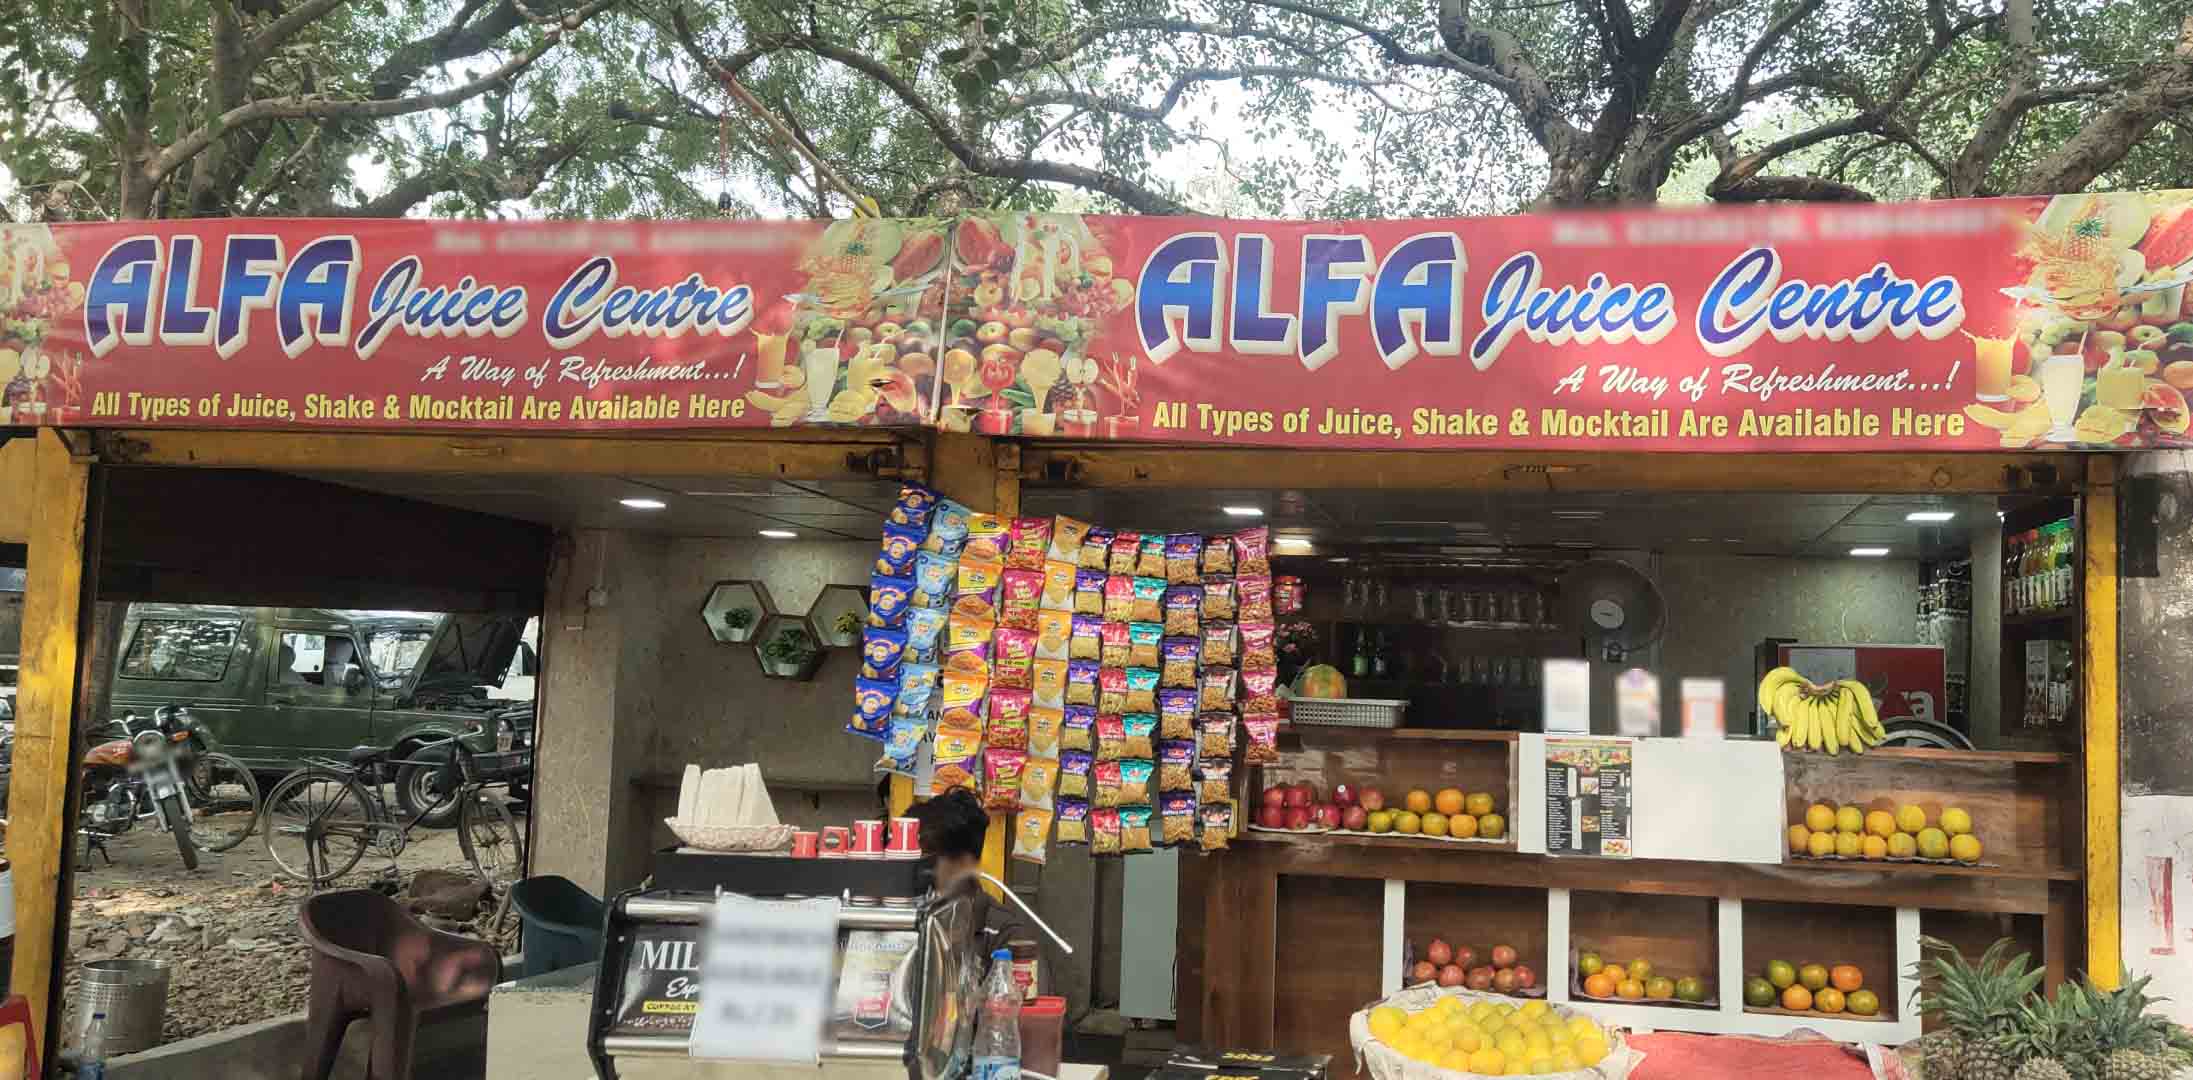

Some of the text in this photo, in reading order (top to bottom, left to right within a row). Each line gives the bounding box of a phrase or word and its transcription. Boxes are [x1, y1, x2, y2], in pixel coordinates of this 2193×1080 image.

[84, 234, 755, 361] ALFA Juice Centre
[1135, 231, 1967, 372] ALFA Juice Centre
[421, 352, 748, 389] A Way of Refreshment...!
[1552, 360, 1962, 401] A Way of Refreshment...!
[91, 391, 745, 421] All Types of Juice, Shake & Mocktail Are Available Here
[1153, 401, 1965, 438] All Types of Juice, Shake & Mocktail Are Available Here
[640, 940, 699, 971] MIL
[665, 976, 699, 999] Esp
